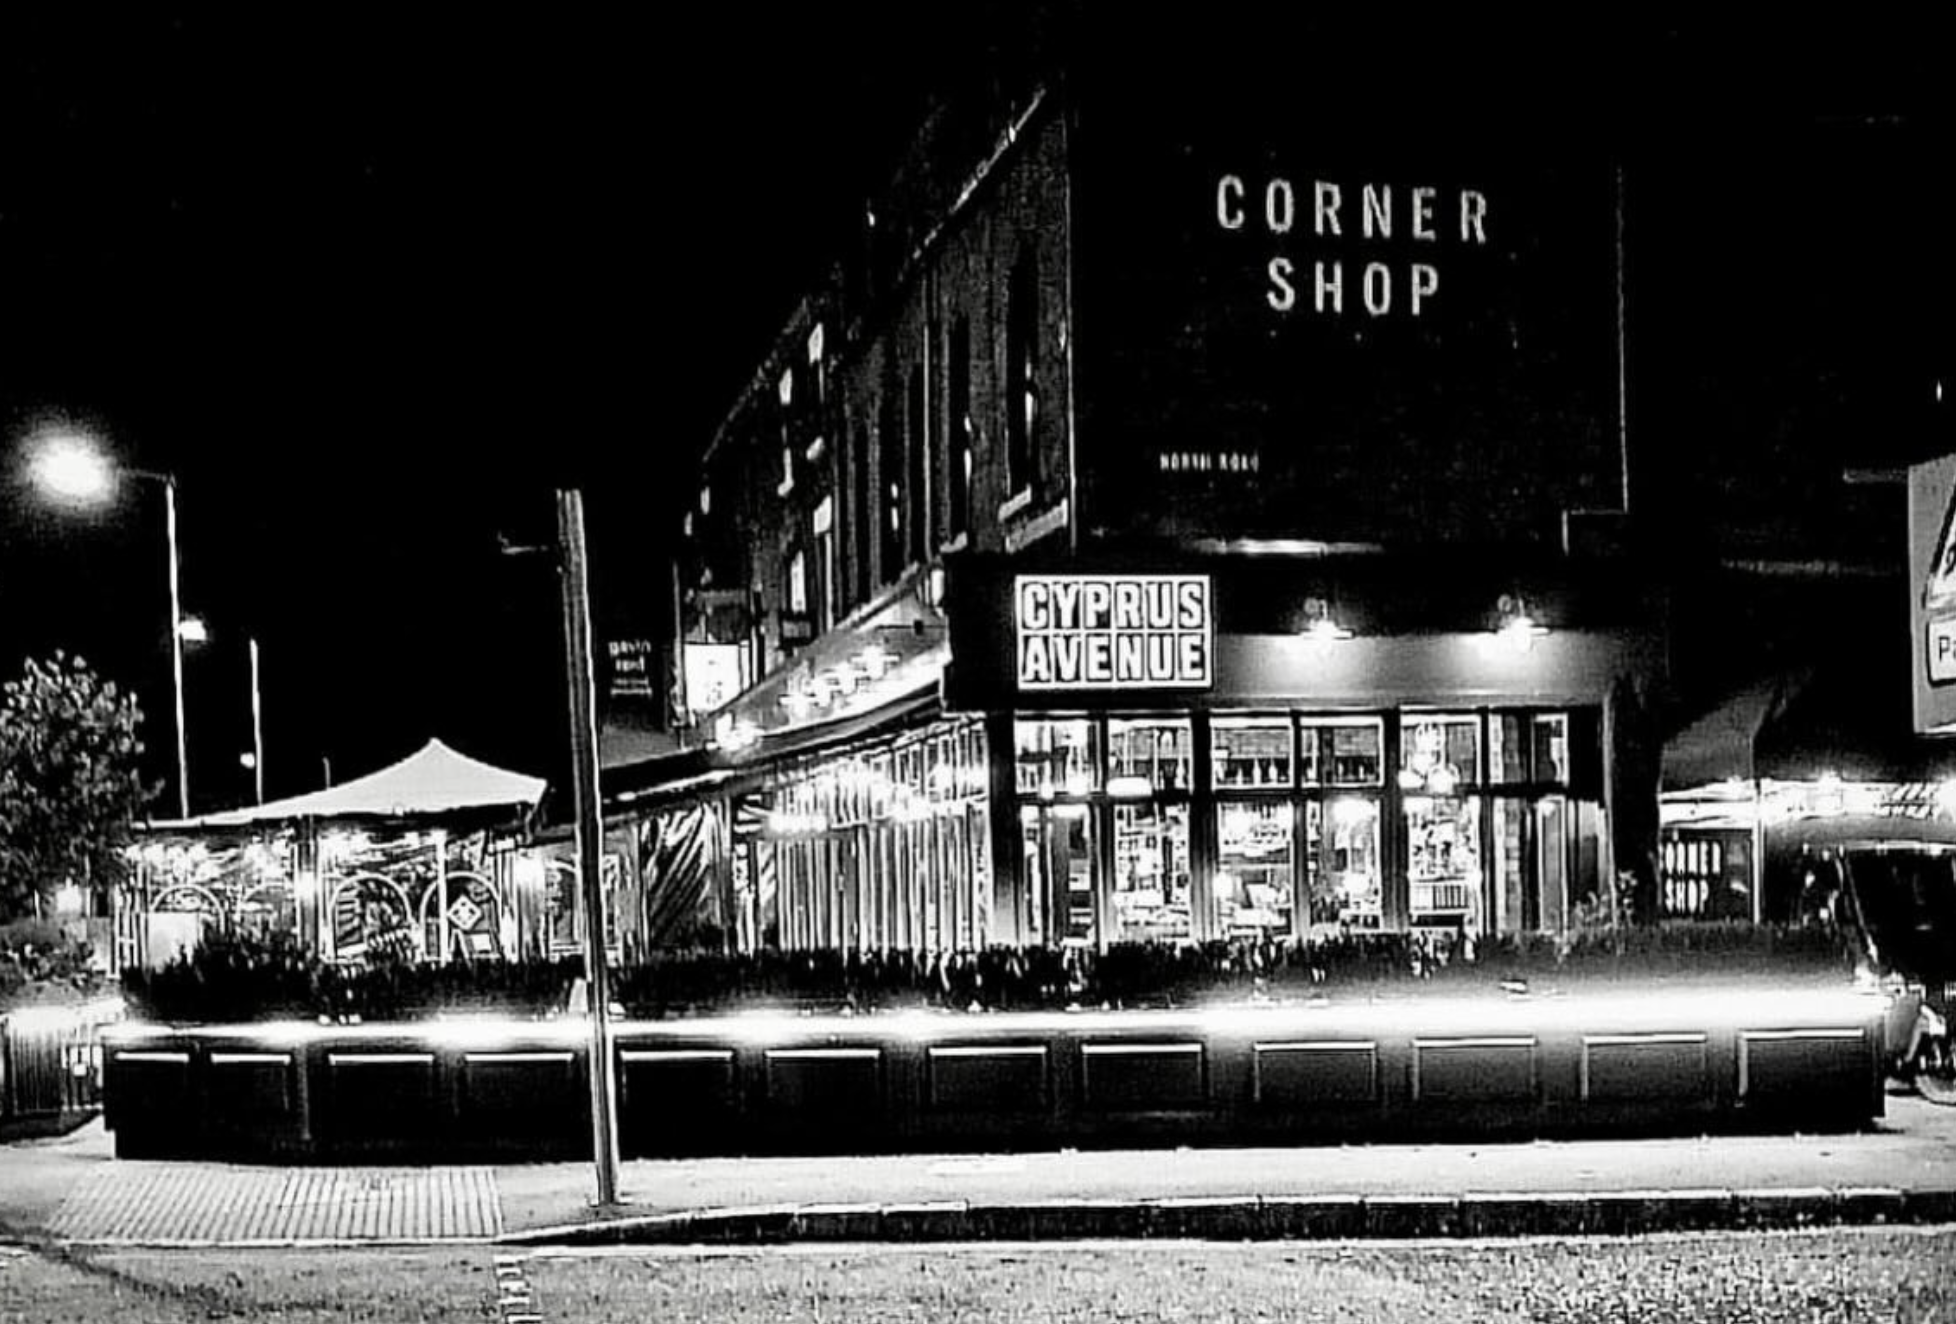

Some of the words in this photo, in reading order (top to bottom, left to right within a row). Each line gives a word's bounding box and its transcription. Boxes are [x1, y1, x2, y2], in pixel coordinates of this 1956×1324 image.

[1216, 173, 1487, 244] CORNER
[1266, 256, 1439, 316] SHOP
[1023, 582, 1203, 628] CYPRUS
[1023, 635, 1203, 680] AVENUE
[1938, 635, 1956, 662] P
[1665, 877, 1709, 914] SHOP
